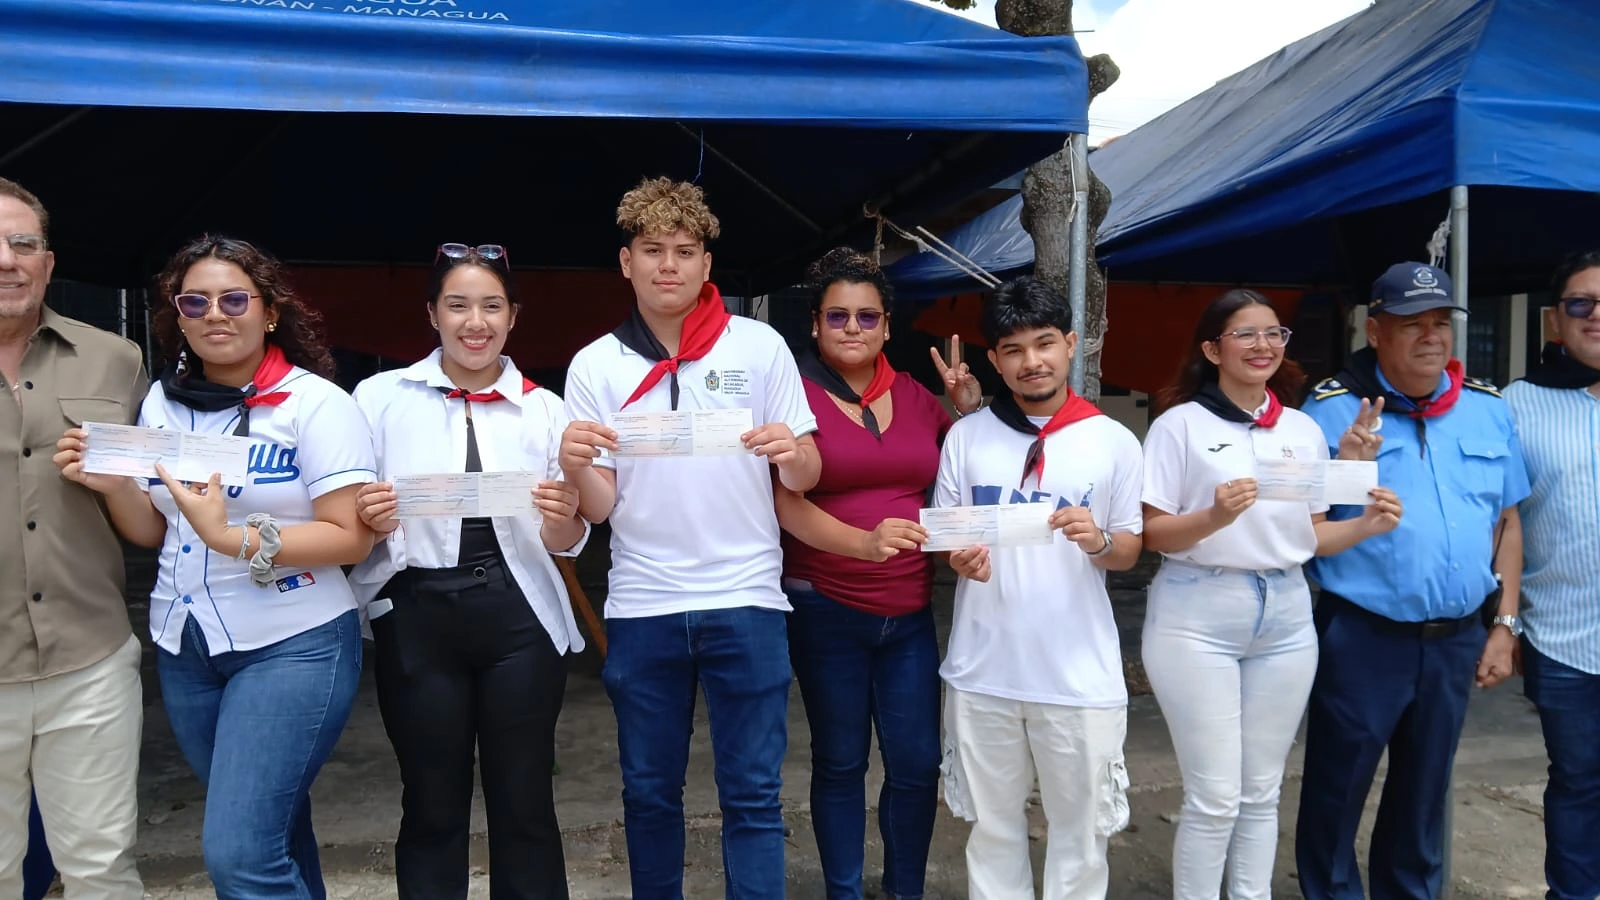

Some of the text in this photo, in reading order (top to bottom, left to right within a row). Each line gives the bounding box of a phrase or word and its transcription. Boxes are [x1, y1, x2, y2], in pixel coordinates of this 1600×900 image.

[219, 0, 315, 9] NAN
[343, 5, 510, 21] MANAGUA
[278, 582, 289, 592] 16
